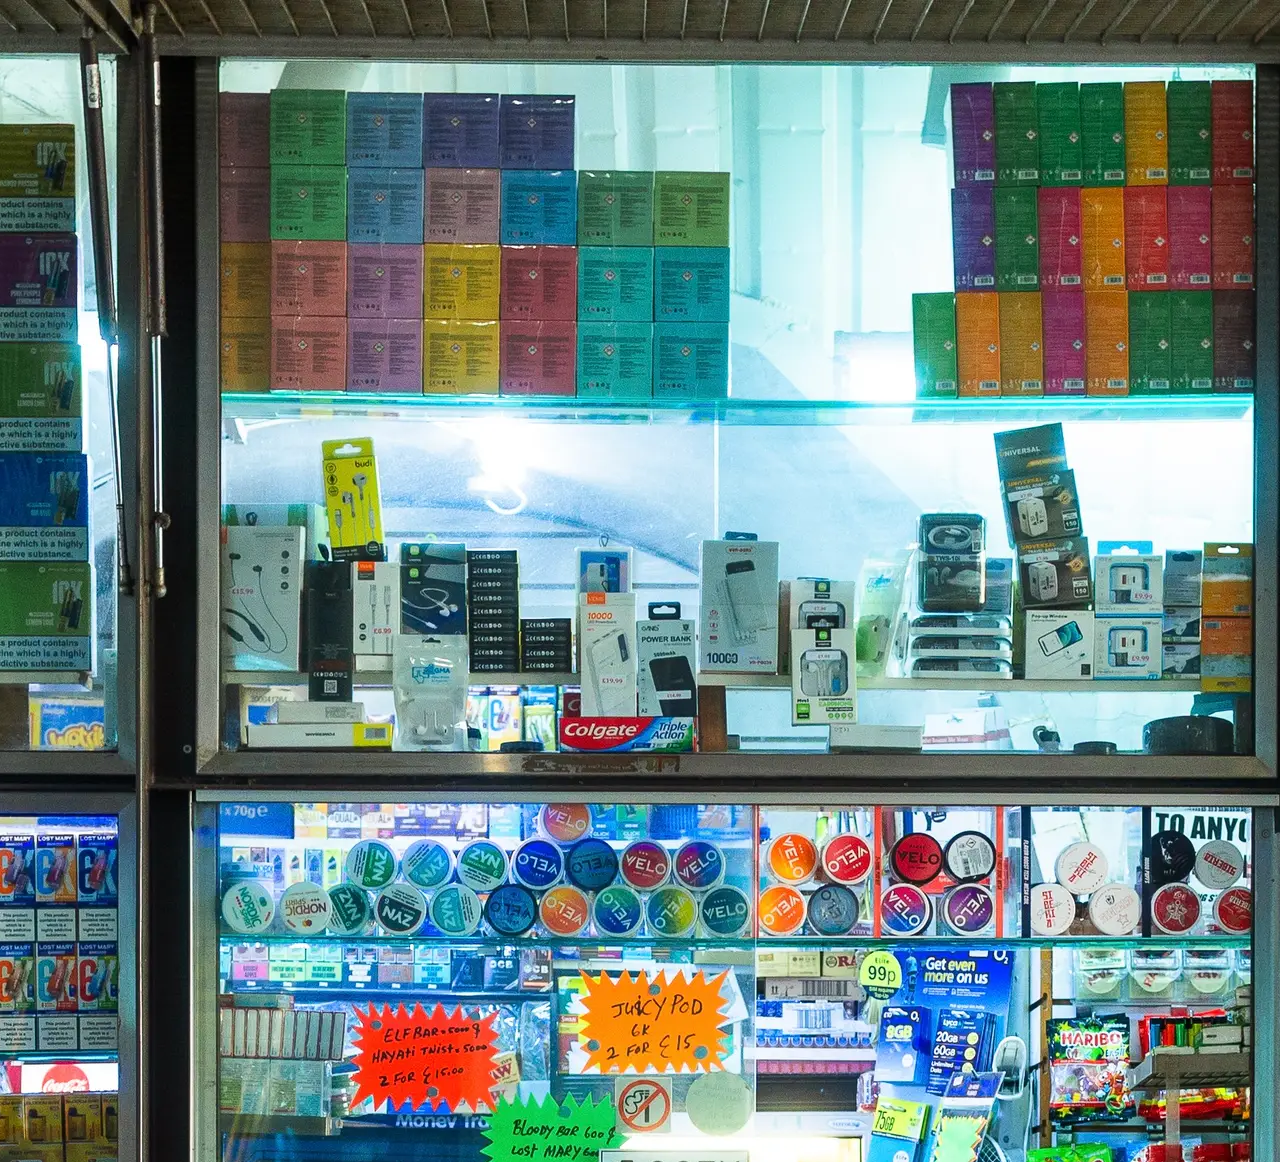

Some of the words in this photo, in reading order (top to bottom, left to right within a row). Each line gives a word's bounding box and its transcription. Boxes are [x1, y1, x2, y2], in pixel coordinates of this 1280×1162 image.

[354, 460, 373, 469] budi
[565, 723, 637, 739] Colgate
[652, 731, 685, 740] Action
[659, 723, 687, 732] Triple
[469, 848, 501, 867] ZYN
[626, 854, 666, 875] VELO
[783, 836, 804, 878] VELO
[703, 903, 747, 919] VELO
[926, 957, 946, 970] Get
[948, 960, 975, 972] even
[868, 966, 896, 985] 99p
[924, 971, 954, 983] more
[956, 973, 973, 983] on
[974, 973, 988, 984] us
[671, 997, 703, 1015] POD
[936, 1032, 958, 1043] 20GB
[607, 1046, 619, 1060] 2
[626, 1042, 649, 1056] FOR
[660, 1034, 696, 1059] £15
[379, 1075, 390, 1087] 2
[393, 1071, 416, 1085] FOR
[396, 1113, 460, 1128] Money
[544, 1145, 581, 1158] MARY
